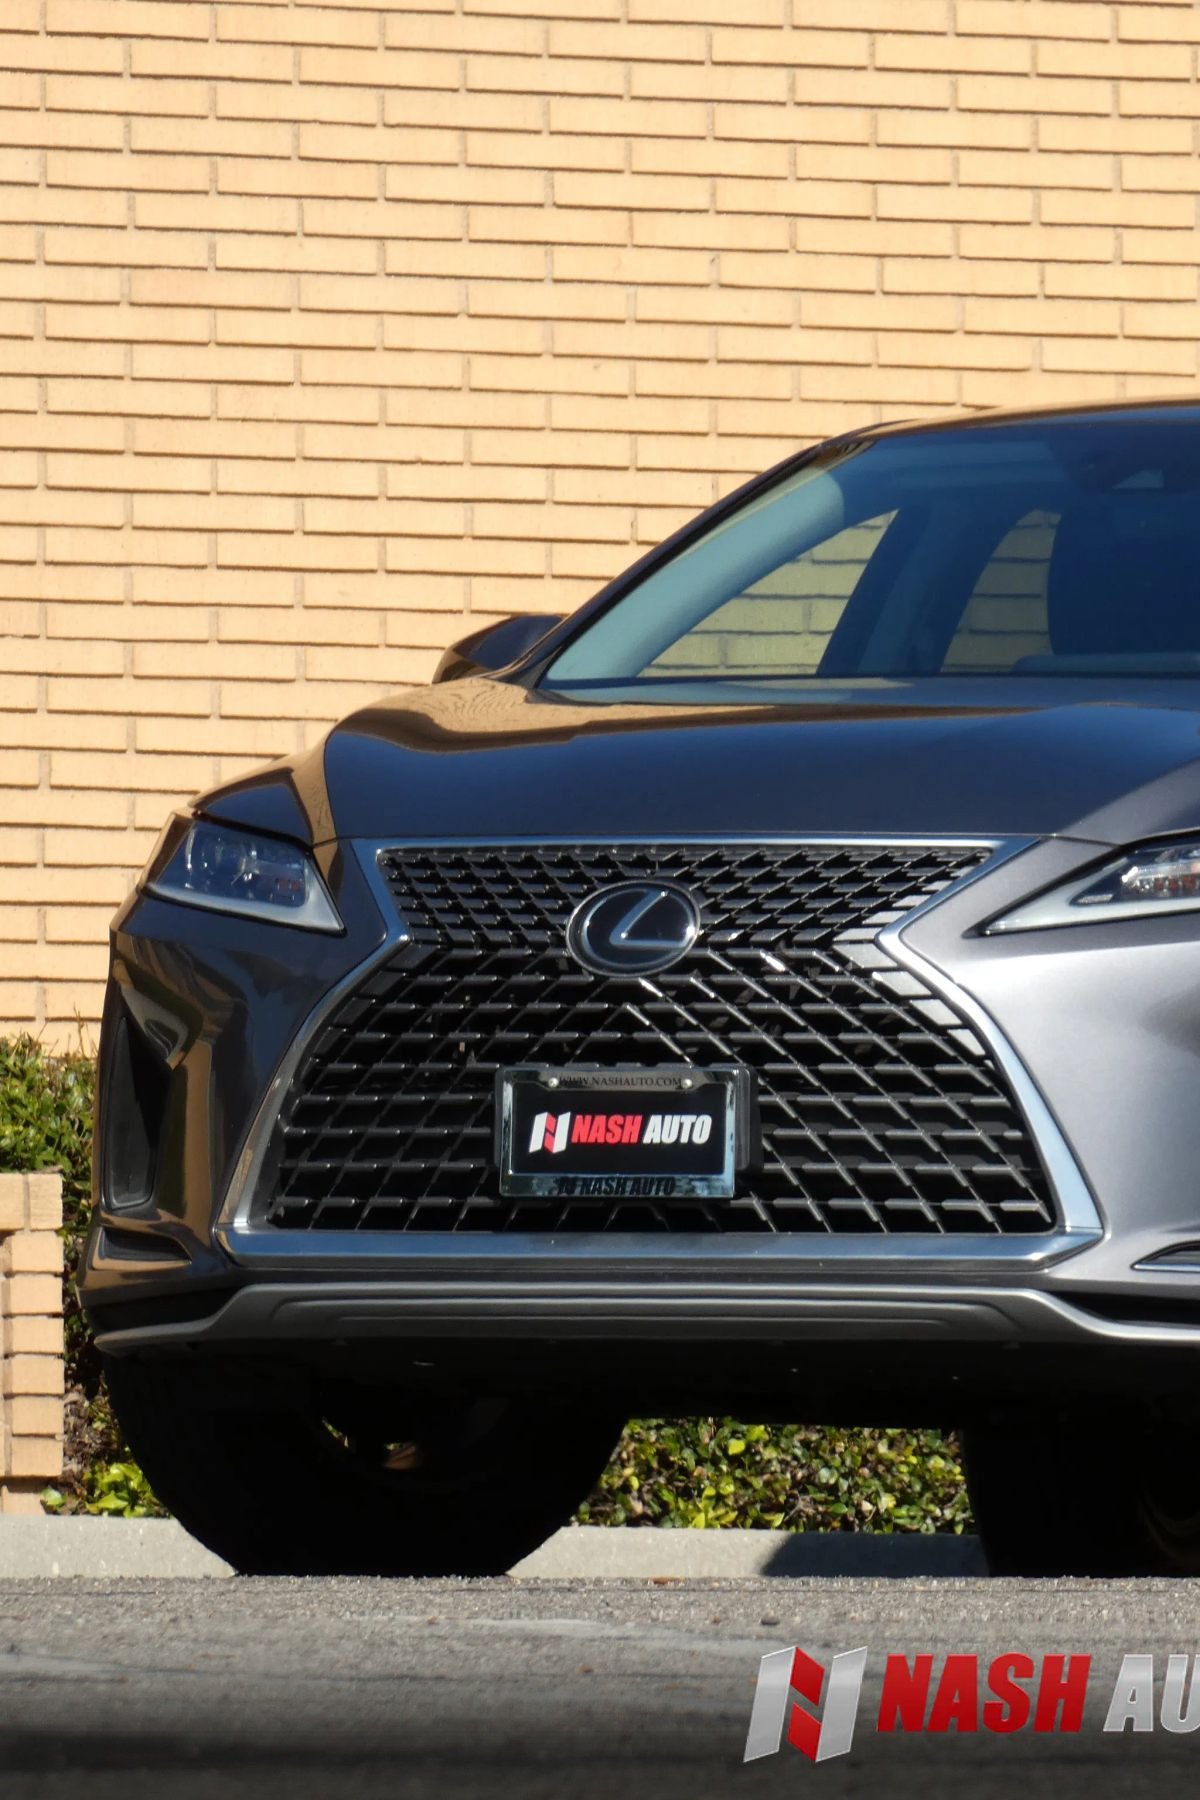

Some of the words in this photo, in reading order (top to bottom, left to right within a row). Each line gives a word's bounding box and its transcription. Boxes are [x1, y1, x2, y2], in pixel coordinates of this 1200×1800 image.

[571, 1114, 643, 1145] NASH
[643, 1114, 713, 1145] AUTO
[580, 1176, 629, 1195] NASH
[629, 1176, 676, 1195] AUTO
